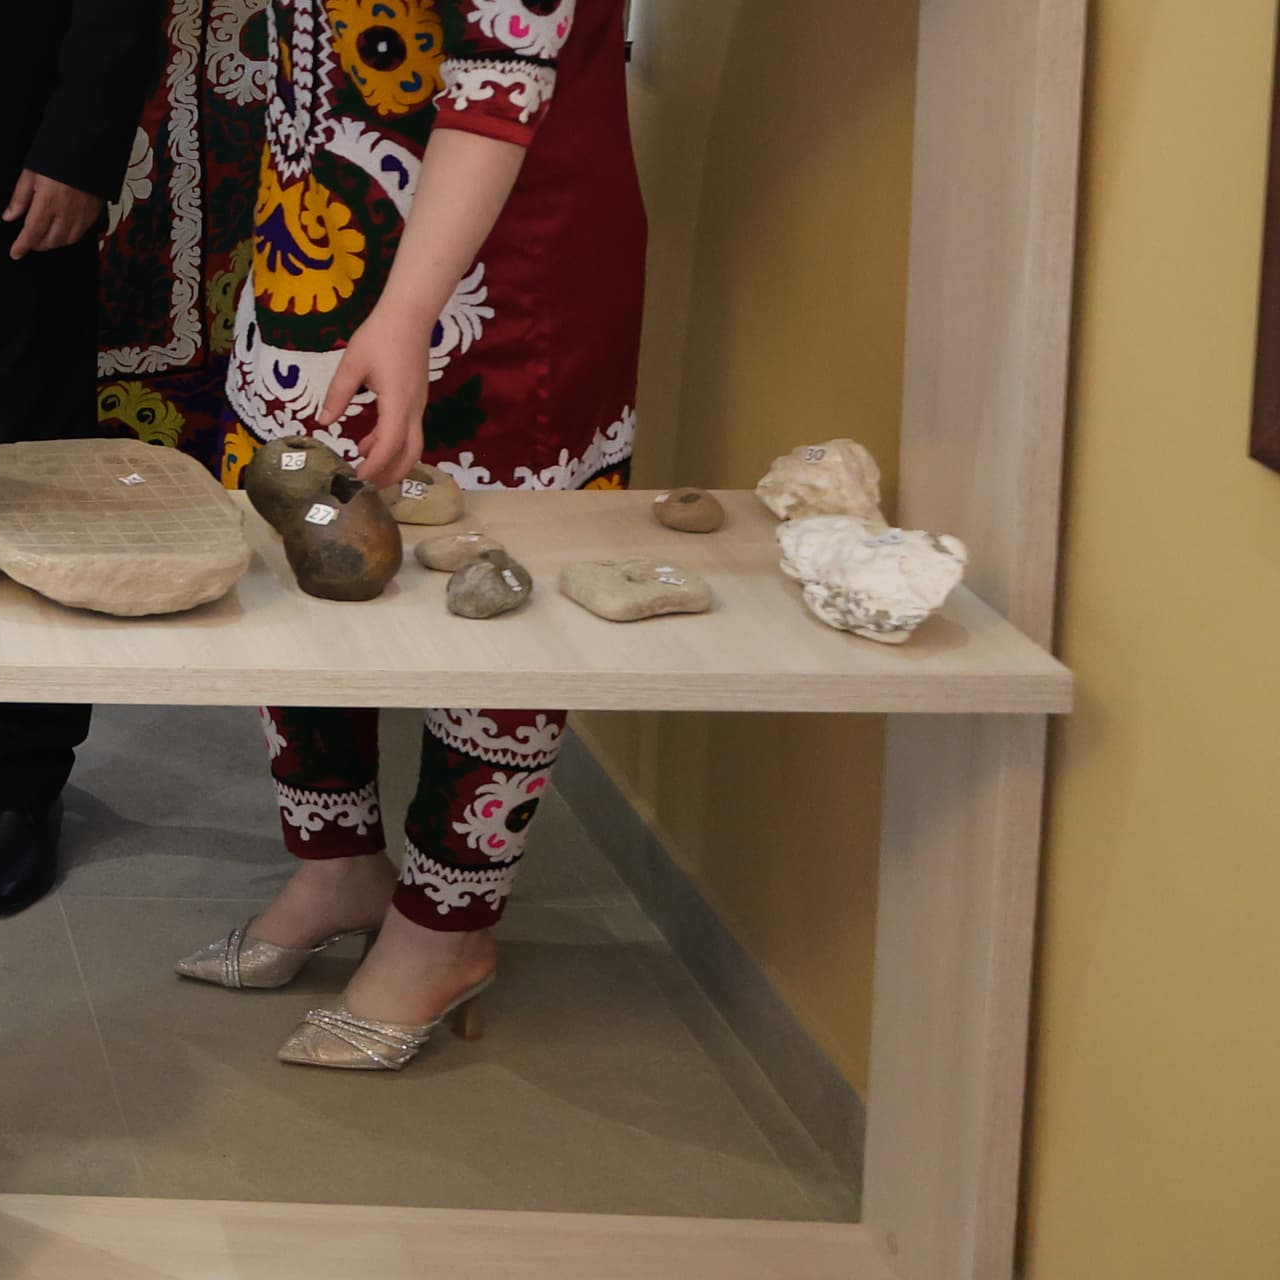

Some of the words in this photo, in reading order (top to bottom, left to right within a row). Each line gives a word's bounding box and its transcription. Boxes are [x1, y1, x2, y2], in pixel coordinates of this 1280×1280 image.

[284, 454, 304, 468] 26
[804, 447, 827, 462] 30
[403, 480, 425, 497] 29
[308, 506, 332, 522] 27
